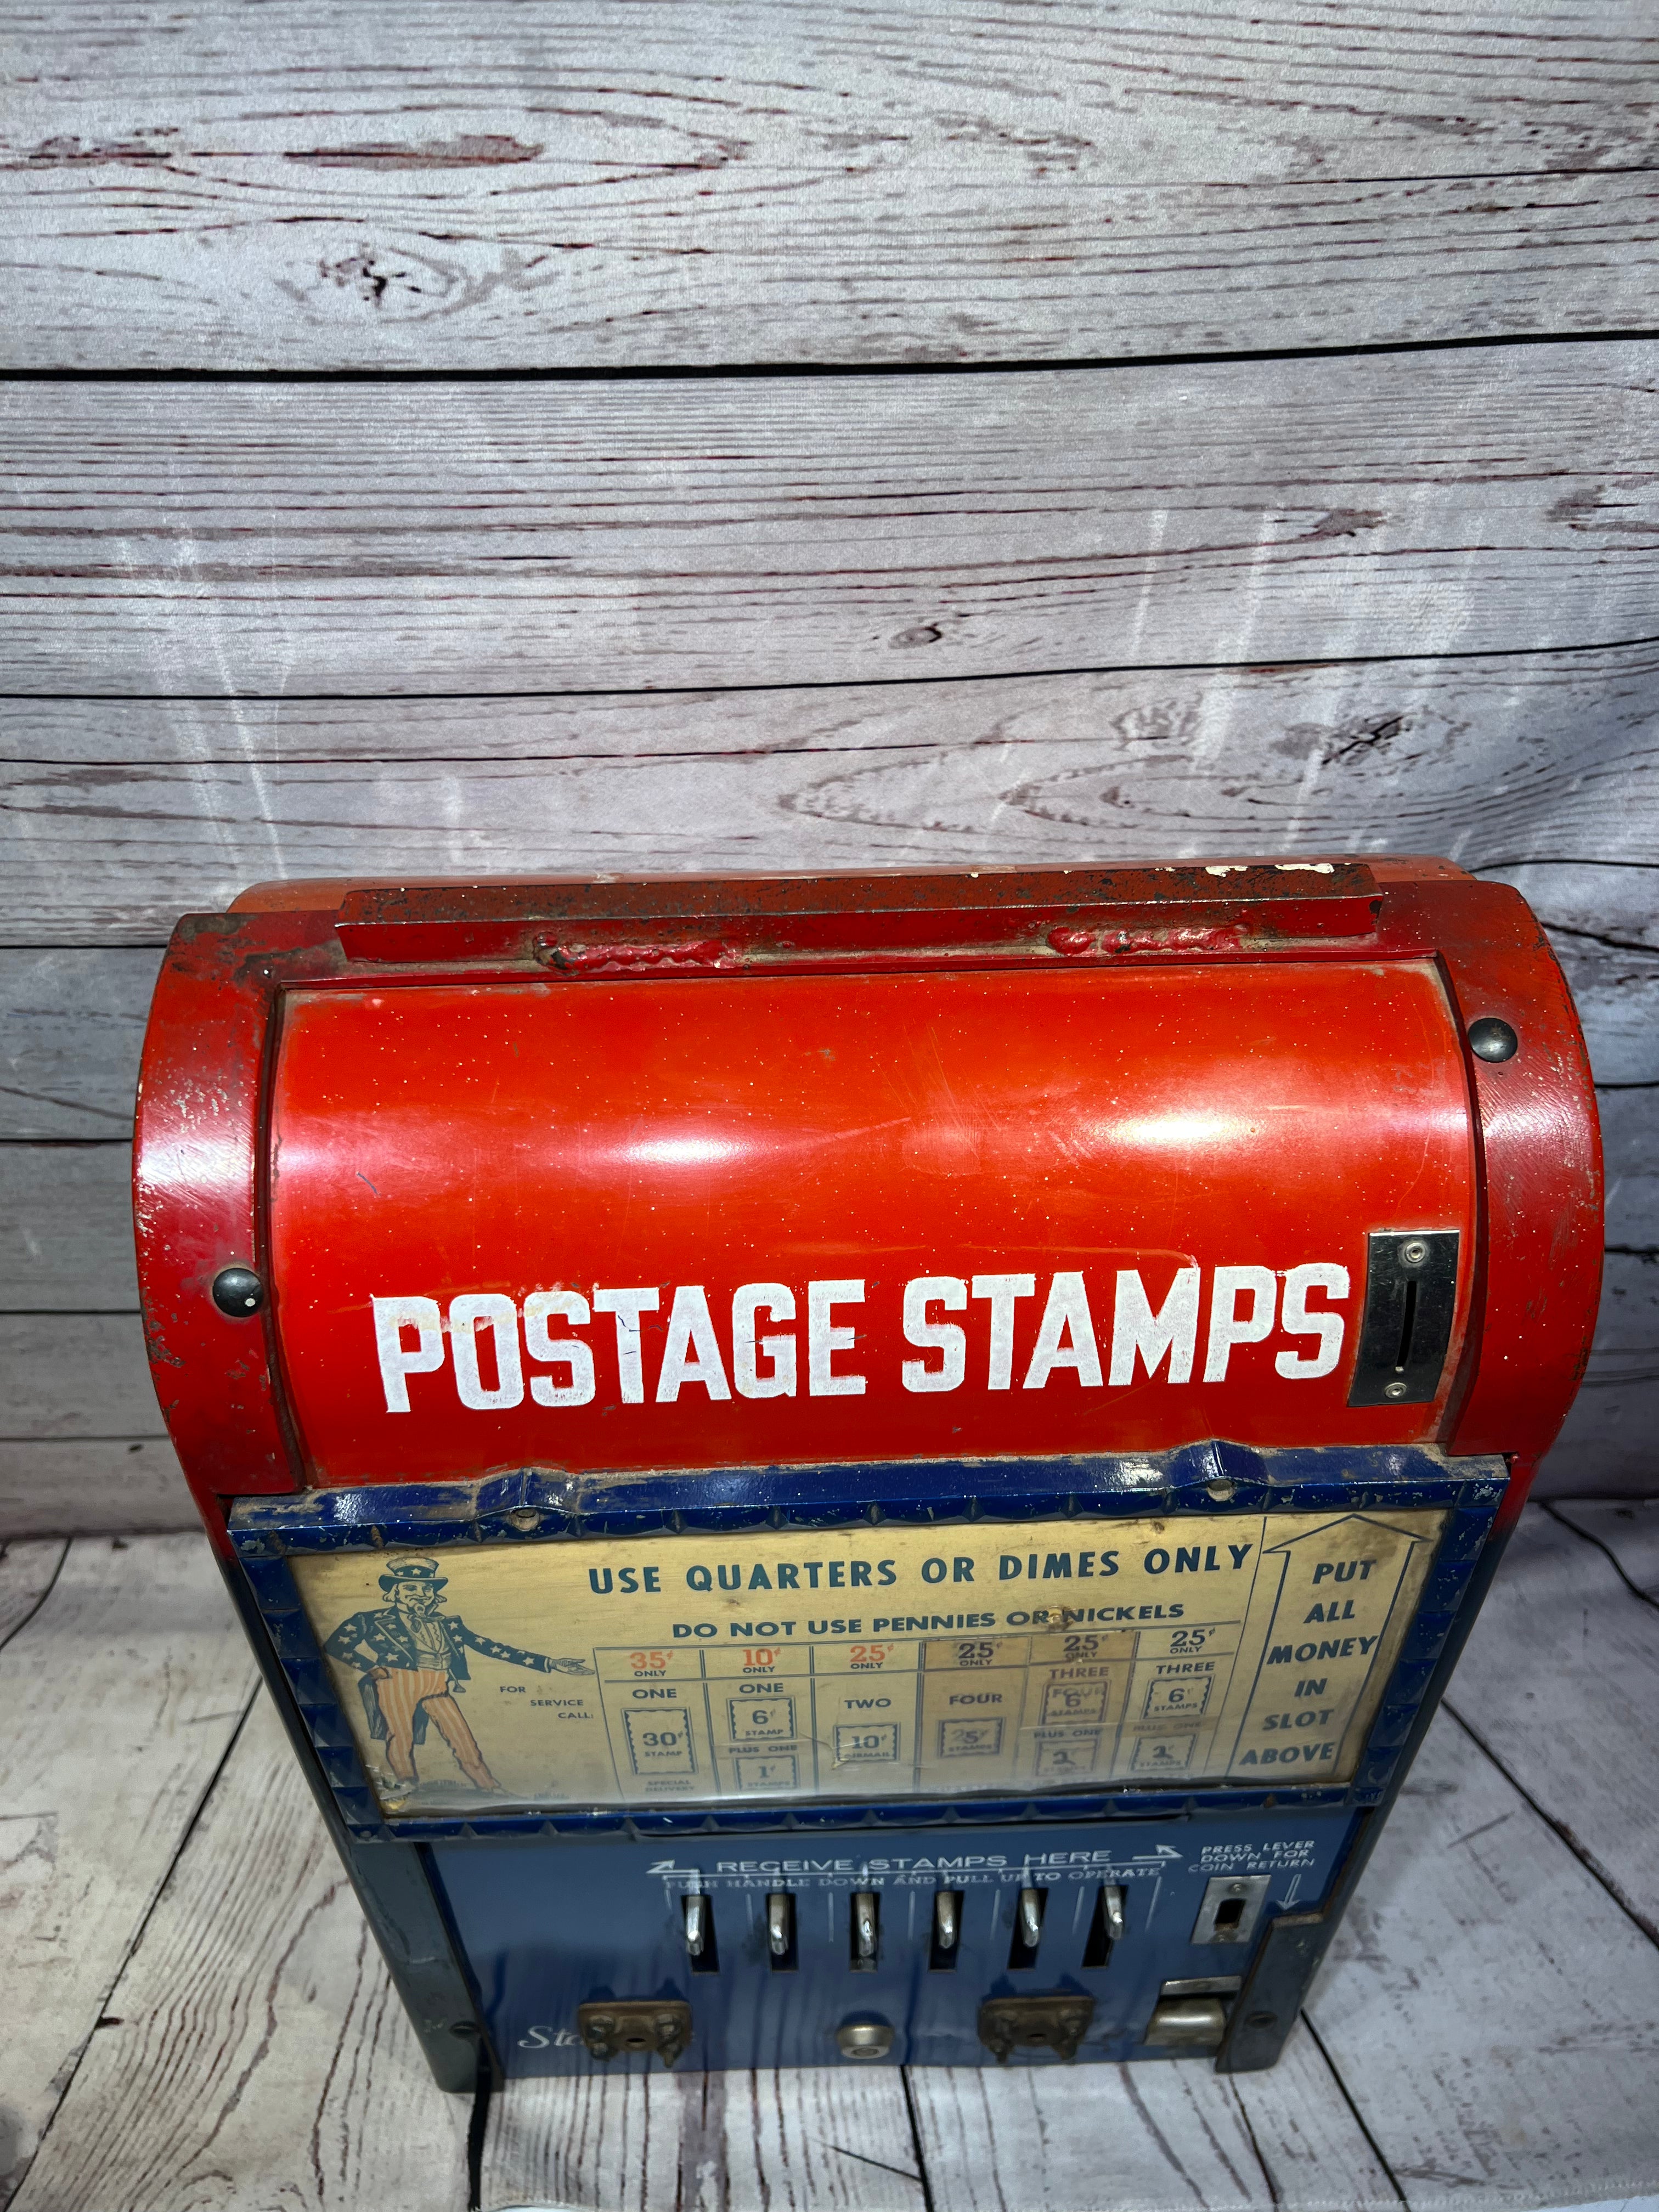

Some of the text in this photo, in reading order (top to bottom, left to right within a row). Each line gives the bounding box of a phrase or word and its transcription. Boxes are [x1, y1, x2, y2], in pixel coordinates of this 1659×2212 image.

[370, 1262, 1350, 1413] POSTAGE STAMPS
[589, 1543, 1254, 1594] USE QUARTERS OR DIMES ONLY
[1312, 1559, 1378, 1584] PUT
[1303, 1599, 1356, 1624] ALL
[673, 1604, 1184, 1638] DO NOT USE PENNIES OR NICKELS
[1064, 1651, 1097, 1661] ONLY
[1169, 1646, 1202, 1655] ONLY
[1266, 1635, 1379, 1664] MONEY
[960, 1658, 992, 1667] ONLY
[1156, 1661, 1216, 1675] THREE
[1050, 1666, 1110, 1679] THREE
[632, 1688, 677, 1700] ONE
[739, 1683, 784, 1694] ONE
[1294, 1678, 1328, 1697] IN
[844, 1698, 891, 1709] TWO
[949, 1693, 1002, 1705] FOUR
[1153, 1702, 1199, 1712] STAMPS
[1262, 1708, 1335, 1731] SLOT
[729, 1744, 798, 1754] PLUS ONE
[1239, 1742, 1336, 1765] ABOVE
[1201, 1840, 1315, 1855] PRESS LEVER
[716, 1850, 1113, 1872] RECEIVE STAMPS HERE
[1200, 1849, 1310, 1864] DOWN FOR
[1188, 1858, 1316, 1874] COIN RETURN
[727, 1878, 810, 1888] HANDLE
[818, 1876, 885, 1886] DOWN
[893, 1874, 936, 1885] AND
[944, 1874, 995, 1884] PULL
[1035, 1871, 1062, 1881] TO
[1068, 1867, 1162, 1880] OPERATE
